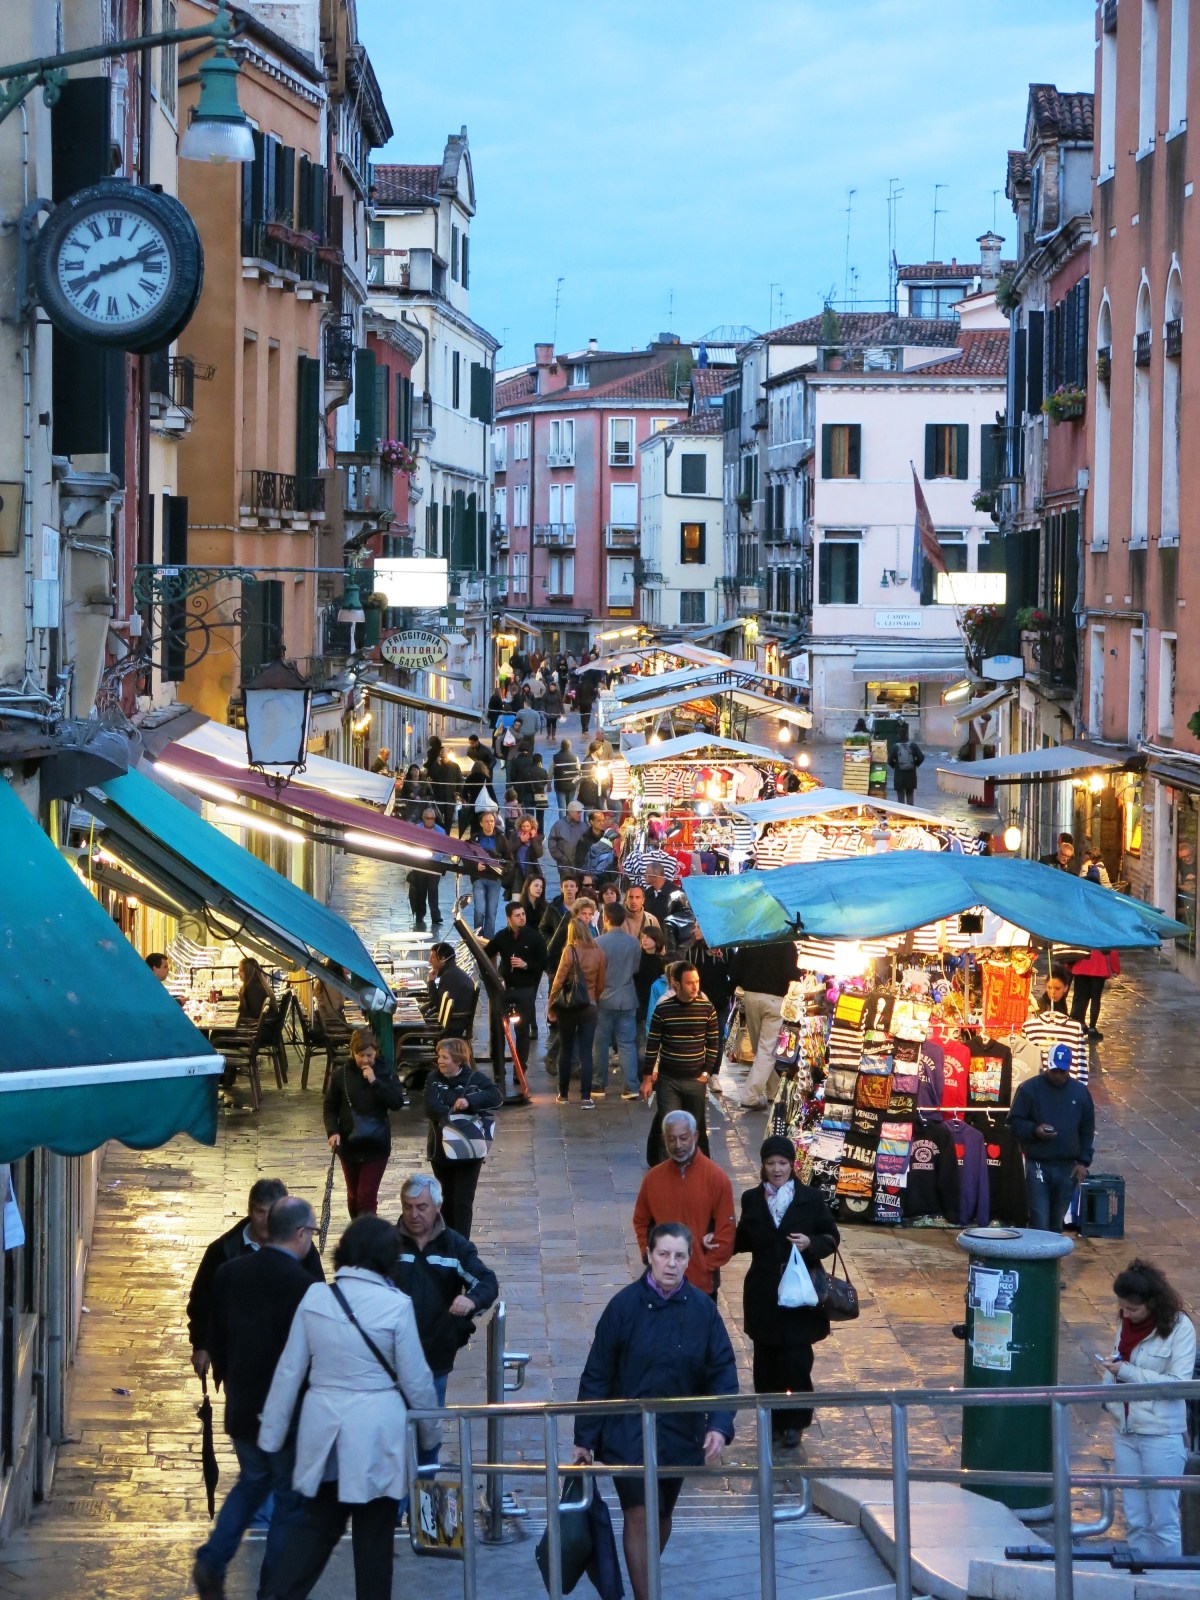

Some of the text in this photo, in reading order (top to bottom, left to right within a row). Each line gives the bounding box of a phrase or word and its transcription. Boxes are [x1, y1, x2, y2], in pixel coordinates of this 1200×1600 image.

[87, 221, 103, 242] XI
[107, 217, 123, 237] XII
[128, 223, 140, 242] I
[70, 237, 91, 254] X
[65, 259, 84, 272] IX
[143, 261, 162, 274] III
[138, 277, 158, 298] IV
[83, 288, 101, 312] VII
[107, 296, 119, 316] VI
[127, 292, 141, 312] V
[387, 631, 440, 647] FRIGGITORIA
[385, 646, 443, 655] TRATTORIA
[399, 654, 434, 668] GAZEBO
[1056, 1051, 1065, 1060] T
[855, 1109, 878, 1122] VENEZIA
